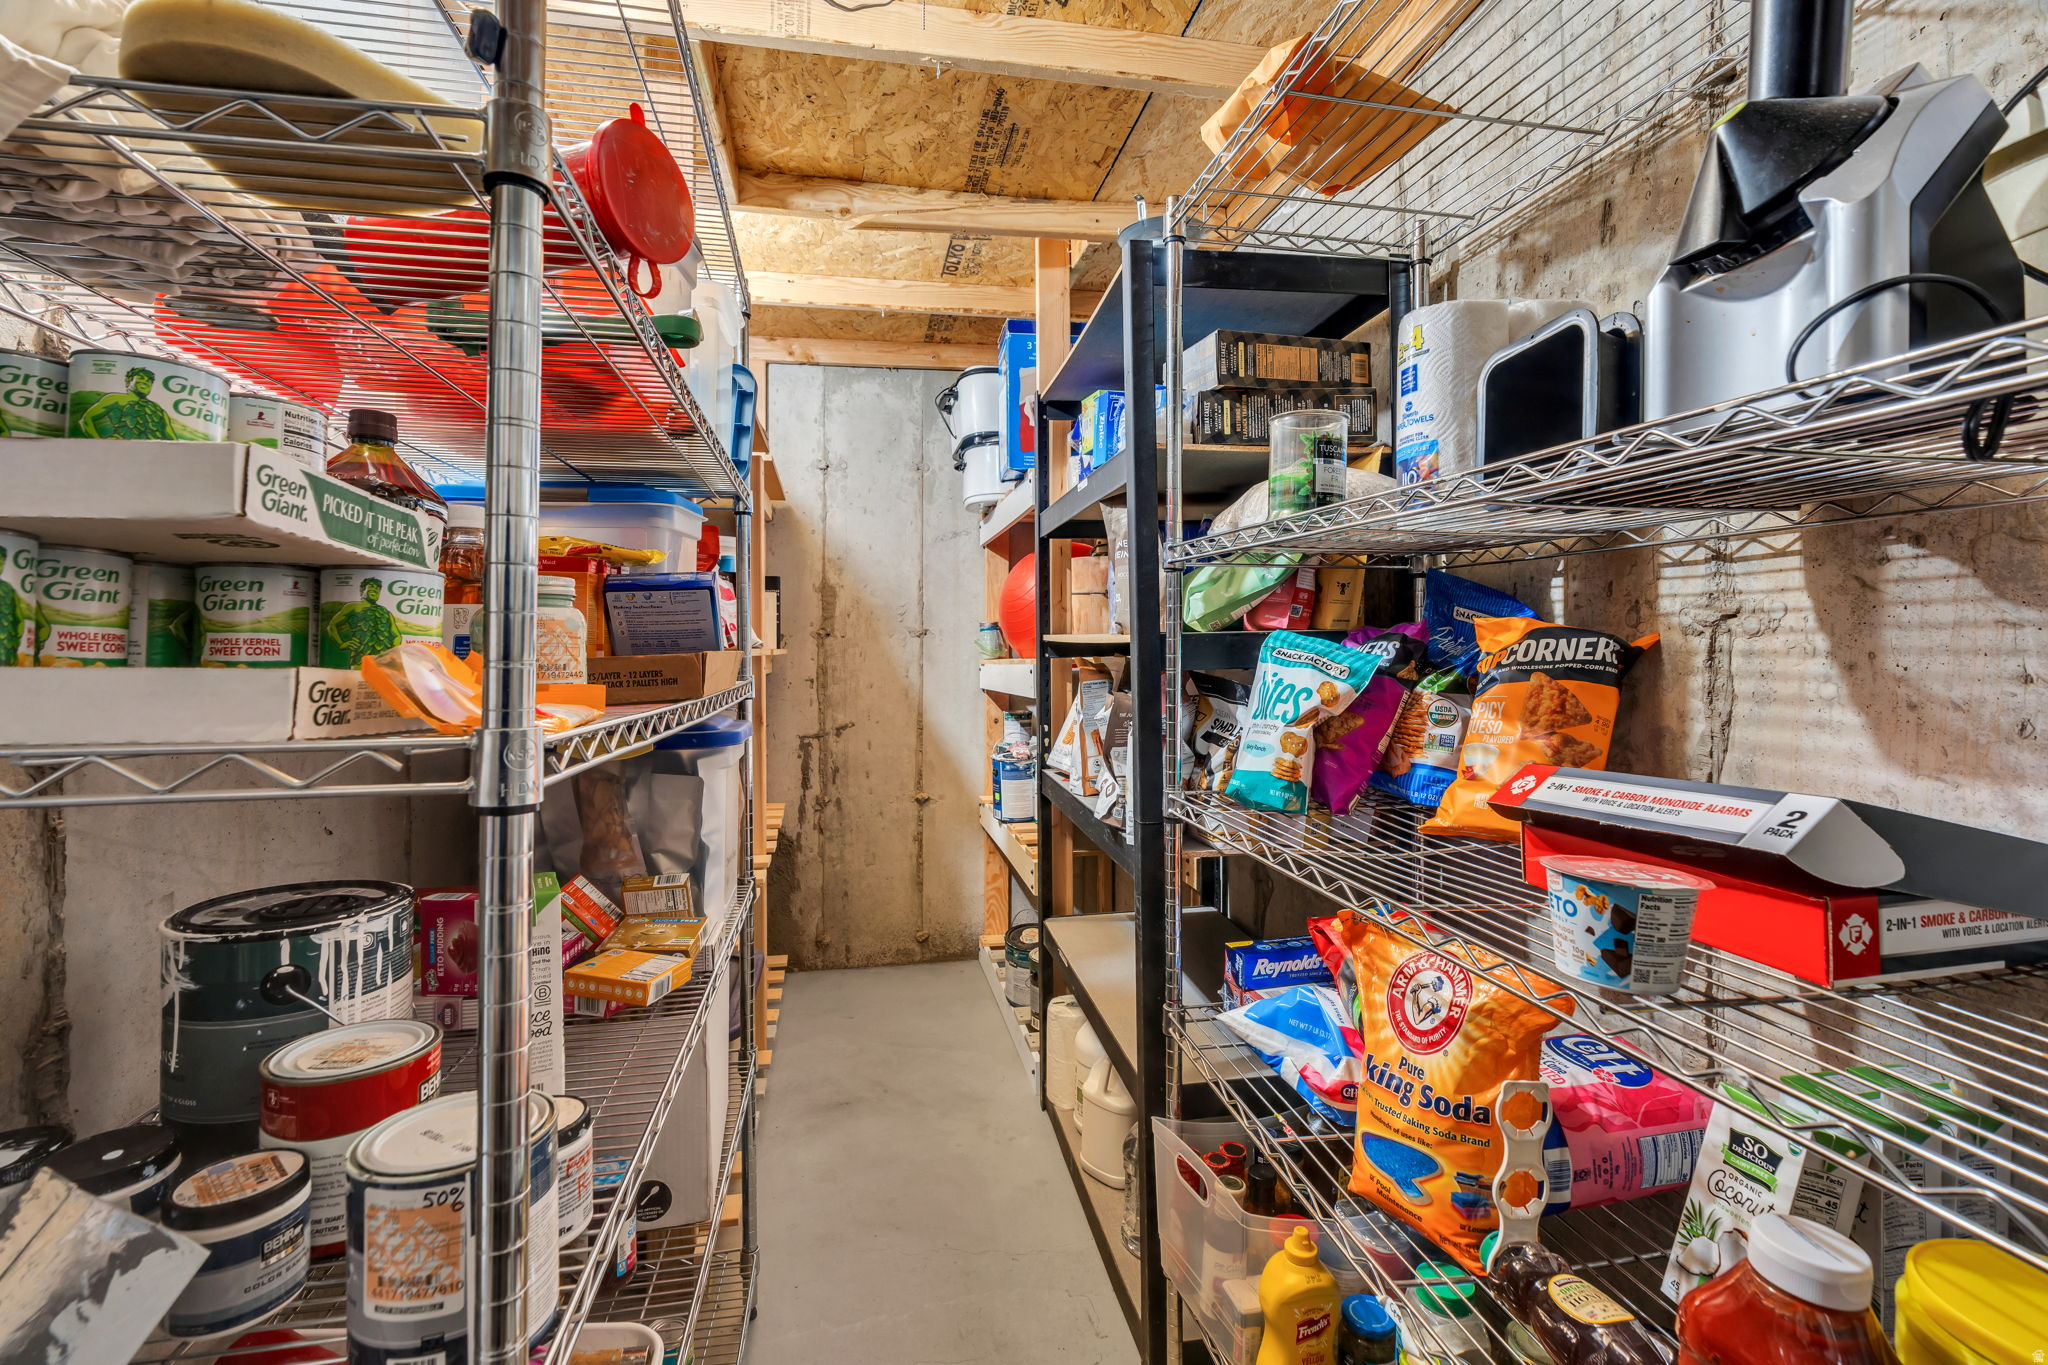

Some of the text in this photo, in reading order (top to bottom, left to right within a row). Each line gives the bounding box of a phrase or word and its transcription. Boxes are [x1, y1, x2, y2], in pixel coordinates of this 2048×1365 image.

[977, 109, 990, 137] SPACING
[943, 243, 965, 276] TOLKO
[1411, 325, 1424, 350] 4
[0, 365, 68, 395] Gree
[162, 375, 228, 409] Green
[172, 398, 228, 429] Giant
[284, 410, 318, 426] Nutrition
[283, 437, 313, 450] Calories
[256, 464, 308, 500] Green
[323, 493, 363, 524] PICKED
[377, 516, 395, 538] THE
[396, 522, 418, 544] PEAK
[367, 533, 420, 558] of perfection
[37, 558, 120, 583] Green
[43, 581, 121, 604] Giant
[199, 576, 264, 592] Green
[387, 580, 442, 599] Green
[203, 594, 266, 611] Giant
[396, 599, 442, 617] Giant
[57, 631, 126, 643] WHOLE KERNE
[57, 642, 126, 653] SWEET CORN
[209, 638, 282, 646] WHOLE KERNEL
[209, 647, 281, 657] SWEET CORN
[1276, 650, 1347, 676] SNACK FACTORY
[588, 672, 621, 681] YS/LAYER
[639, 670, 663, 679] LAYERS
[632, 679, 659, 687] PALLETS
[661, 678, 678, 686] HIGH
[309, 681, 351, 703] Gree
[1252, 670, 1313, 724] bites
[1431, 713, 1455, 721] ORGANIC
[1435, 705, 1452, 713] USDA
[1471, 701, 1505, 719] SPICY
[1468, 720, 1503, 737] QUESO
[1547, 782, 1572, 792] 2-IN-1
[1572, 785, 1602, 796] SMOKE
[1611, 790, 1650, 803] CARBON
[1650, 796, 1704, 812] MONOXIDE
[1705, 804, 1753, 818] ALARMS
[1582, 796, 1599, 804] WITH
[1599, 799, 1616, 807] VOICE
[1623, 802, 1654, 812] LOCATION
[1655, 806, 1683, 816] ALERTS
[1777, 810, 1808, 830] 2
[1763, 827, 1798, 840] PACK
[1550, 893, 1578, 918] ETO
[1640, 903, 1661, 911] Facts
[1641, 894, 1673, 904] Nutrition
[1886, 916, 1917, 932] 2-IN-1
[1920, 912, 1956, 928] SMOKE
[1958, 912, 1966, 923] &
[1942, 927, 1961, 939] WITH
[1963, 925, 1982, 937] VOICE
[1984, 924, 1990, 933] &
[1992, 921, 2025, 934] LOCATION
[1252, 954, 1323, 979] Reynolds
[1392, 955, 1468, 1019] ARM & HAMMER
[1289, 1019, 1298, 1028] NET
[1300, 1022, 1308, 1030] WT
[1313, 1027, 1319, 1035] LB
[1399, 1021, 1420, 1042] STANDARD
[1421, 1036, 1429, 1044] OF
[1429, 1026, 1447, 1042] PURITY
[1399, 1056, 1425, 1080] Pure
[420, 1070, 441, 1102] BEH
[1365, 1054, 1491, 1125] king Soda
[1374, 1098, 1490, 1148] Trusted Baking Soda Brand
[1393, 1127, 1400, 1135] of
[1401, 1131, 1416, 1143] uses
[1417, 1137, 1433, 1149] like:
[1741, 1136, 1769, 1160] SO
[1730, 1157, 1770, 1180] DAIRY FREE
[1731, 1144, 1774, 1172] DELICIOUS
[1376, 1179, 1391, 1195] Pool
[1728, 1172, 1763, 1198] ORGANIC
[1803, 1169, 1844, 1187] Nutrition Facts
[422, 1187, 465, 1212] 50%
[1707, 1169, 1776, 1217] Coconut
[1376, 1188, 1422, 1223] Maintenance
[1712, 1200, 1751, 1227] unsweeten
[1825, 1201, 1838, 1210] 45
[324, 1214, 345, 1223] QUART
[244, 1271, 282, 1294] COLOR
[1670, 1279, 1681, 1291] 45
[1298, 1318, 1329, 1339] French's
[1301, 1354, 1325, 1364] YELLOW
